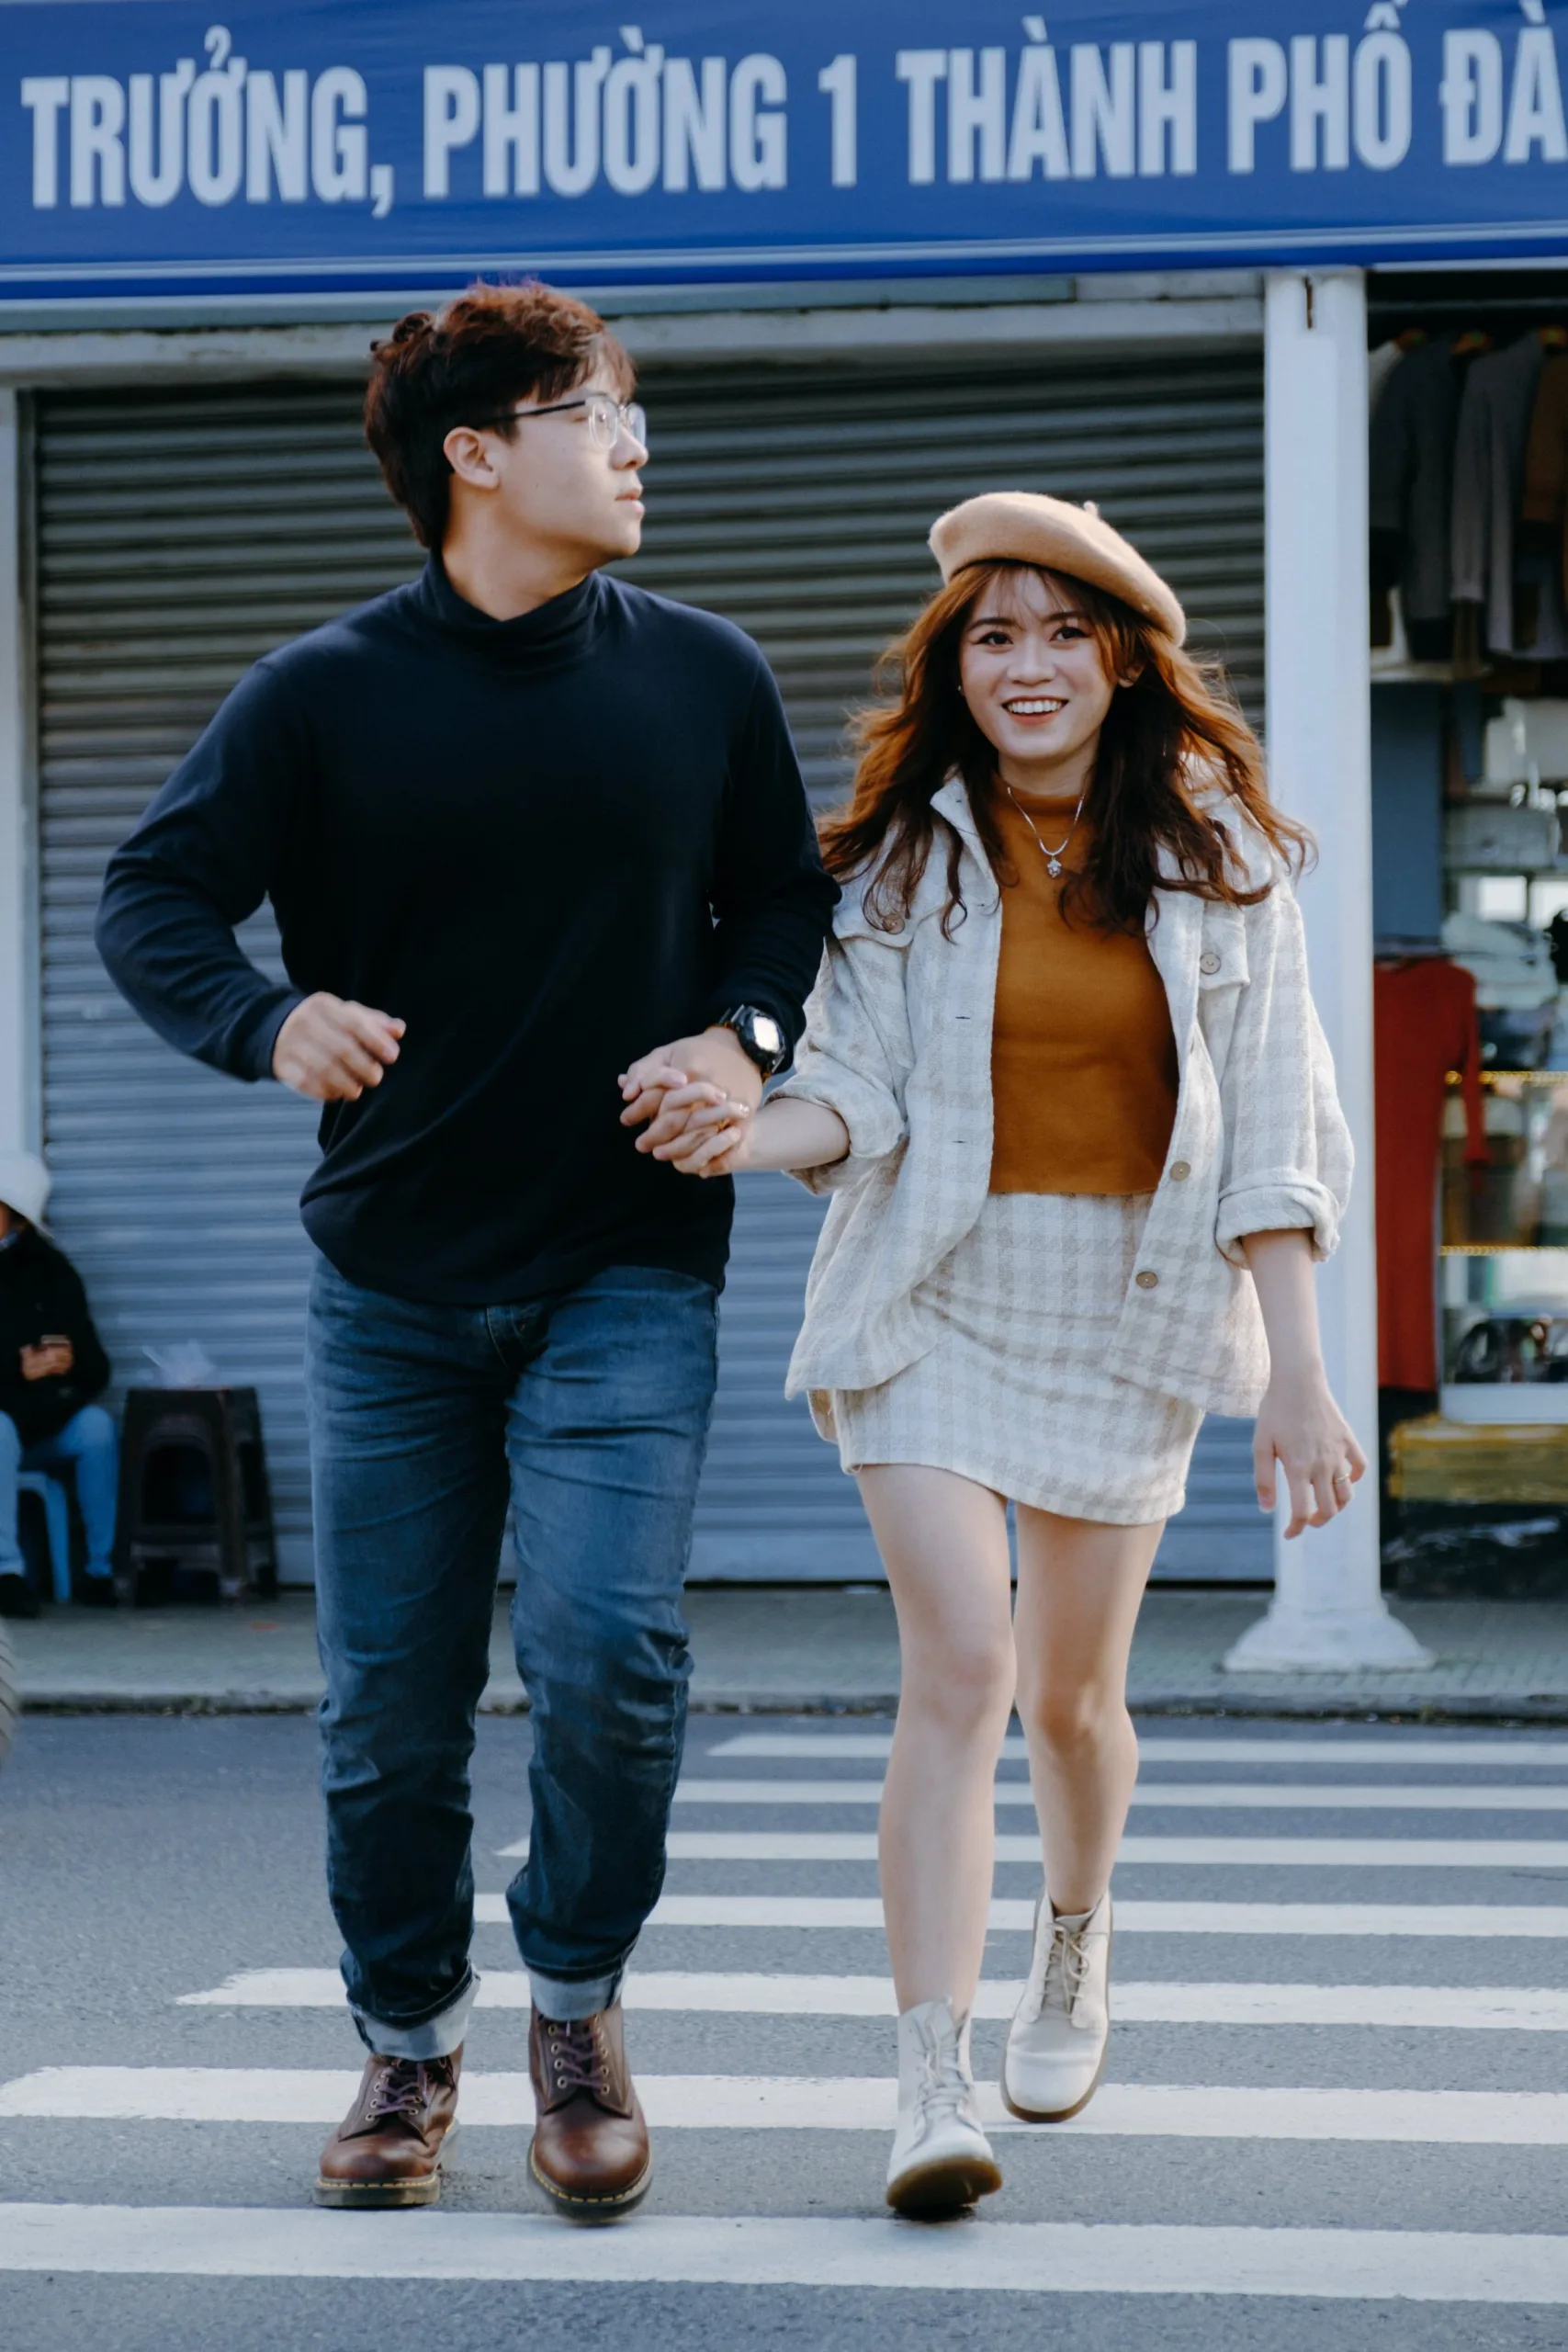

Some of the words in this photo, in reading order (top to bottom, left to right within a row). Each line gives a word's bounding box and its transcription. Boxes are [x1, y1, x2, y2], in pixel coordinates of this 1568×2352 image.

[20, 25, 393, 219] TRƯỞNG,
[423, 25, 788, 198] PHƯỜNG
[819, 55, 856, 187] 1
[897, 17, 1198, 185] THÀNH
[1228, 0, 1413, 174] PHỐ
[1438, 0, 1568, 165] ĐÀ
